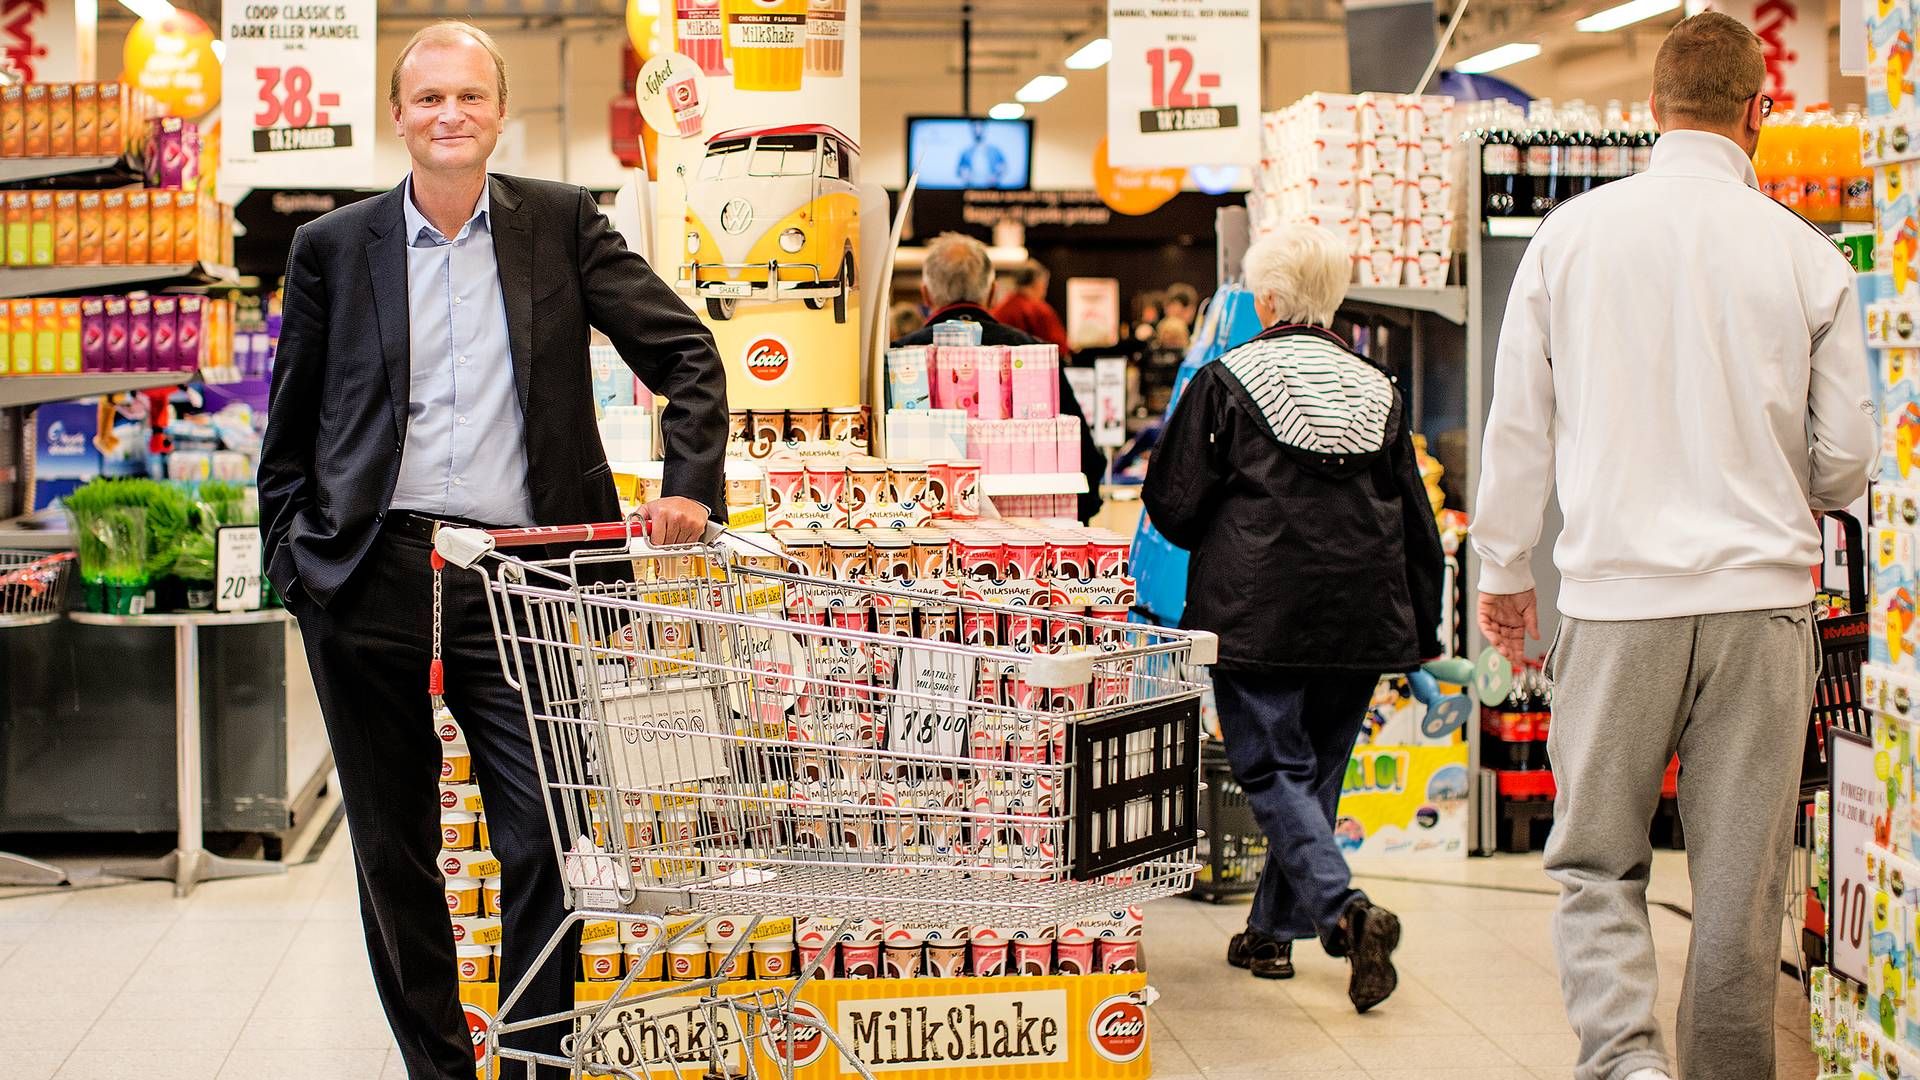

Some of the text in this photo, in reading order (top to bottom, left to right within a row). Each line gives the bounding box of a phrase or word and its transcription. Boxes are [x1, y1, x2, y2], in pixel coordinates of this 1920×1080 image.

[245, 5, 345, 20] COOP CLASSIC IS
[231, 25, 360, 39] DARK ELLER MANDEL
[741, 26, 795, 44] MilkShake
[643, 59, 673, 101] Nyhed
[719, 286, 741, 295] SHAKE
[748, 345, 788, 368] Cocio
[785, 511, 831, 519] MILKSHAKE
[869, 511, 914, 519] MILKSHAKE
[221, 575, 246, 600] 20
[983, 586, 1032, 596] MILKSHAKE
[1068, 586, 1118, 595] MILKSHAKE
[1838, 877, 1867, 950] 10
[902, 922, 950, 931] MILKSHAKE
[1076, 919, 1124, 928] MILKSHAKE
[1096, 1010, 1145, 1037] Cocio
[849, 1001, 1058, 1067] MilkShake
